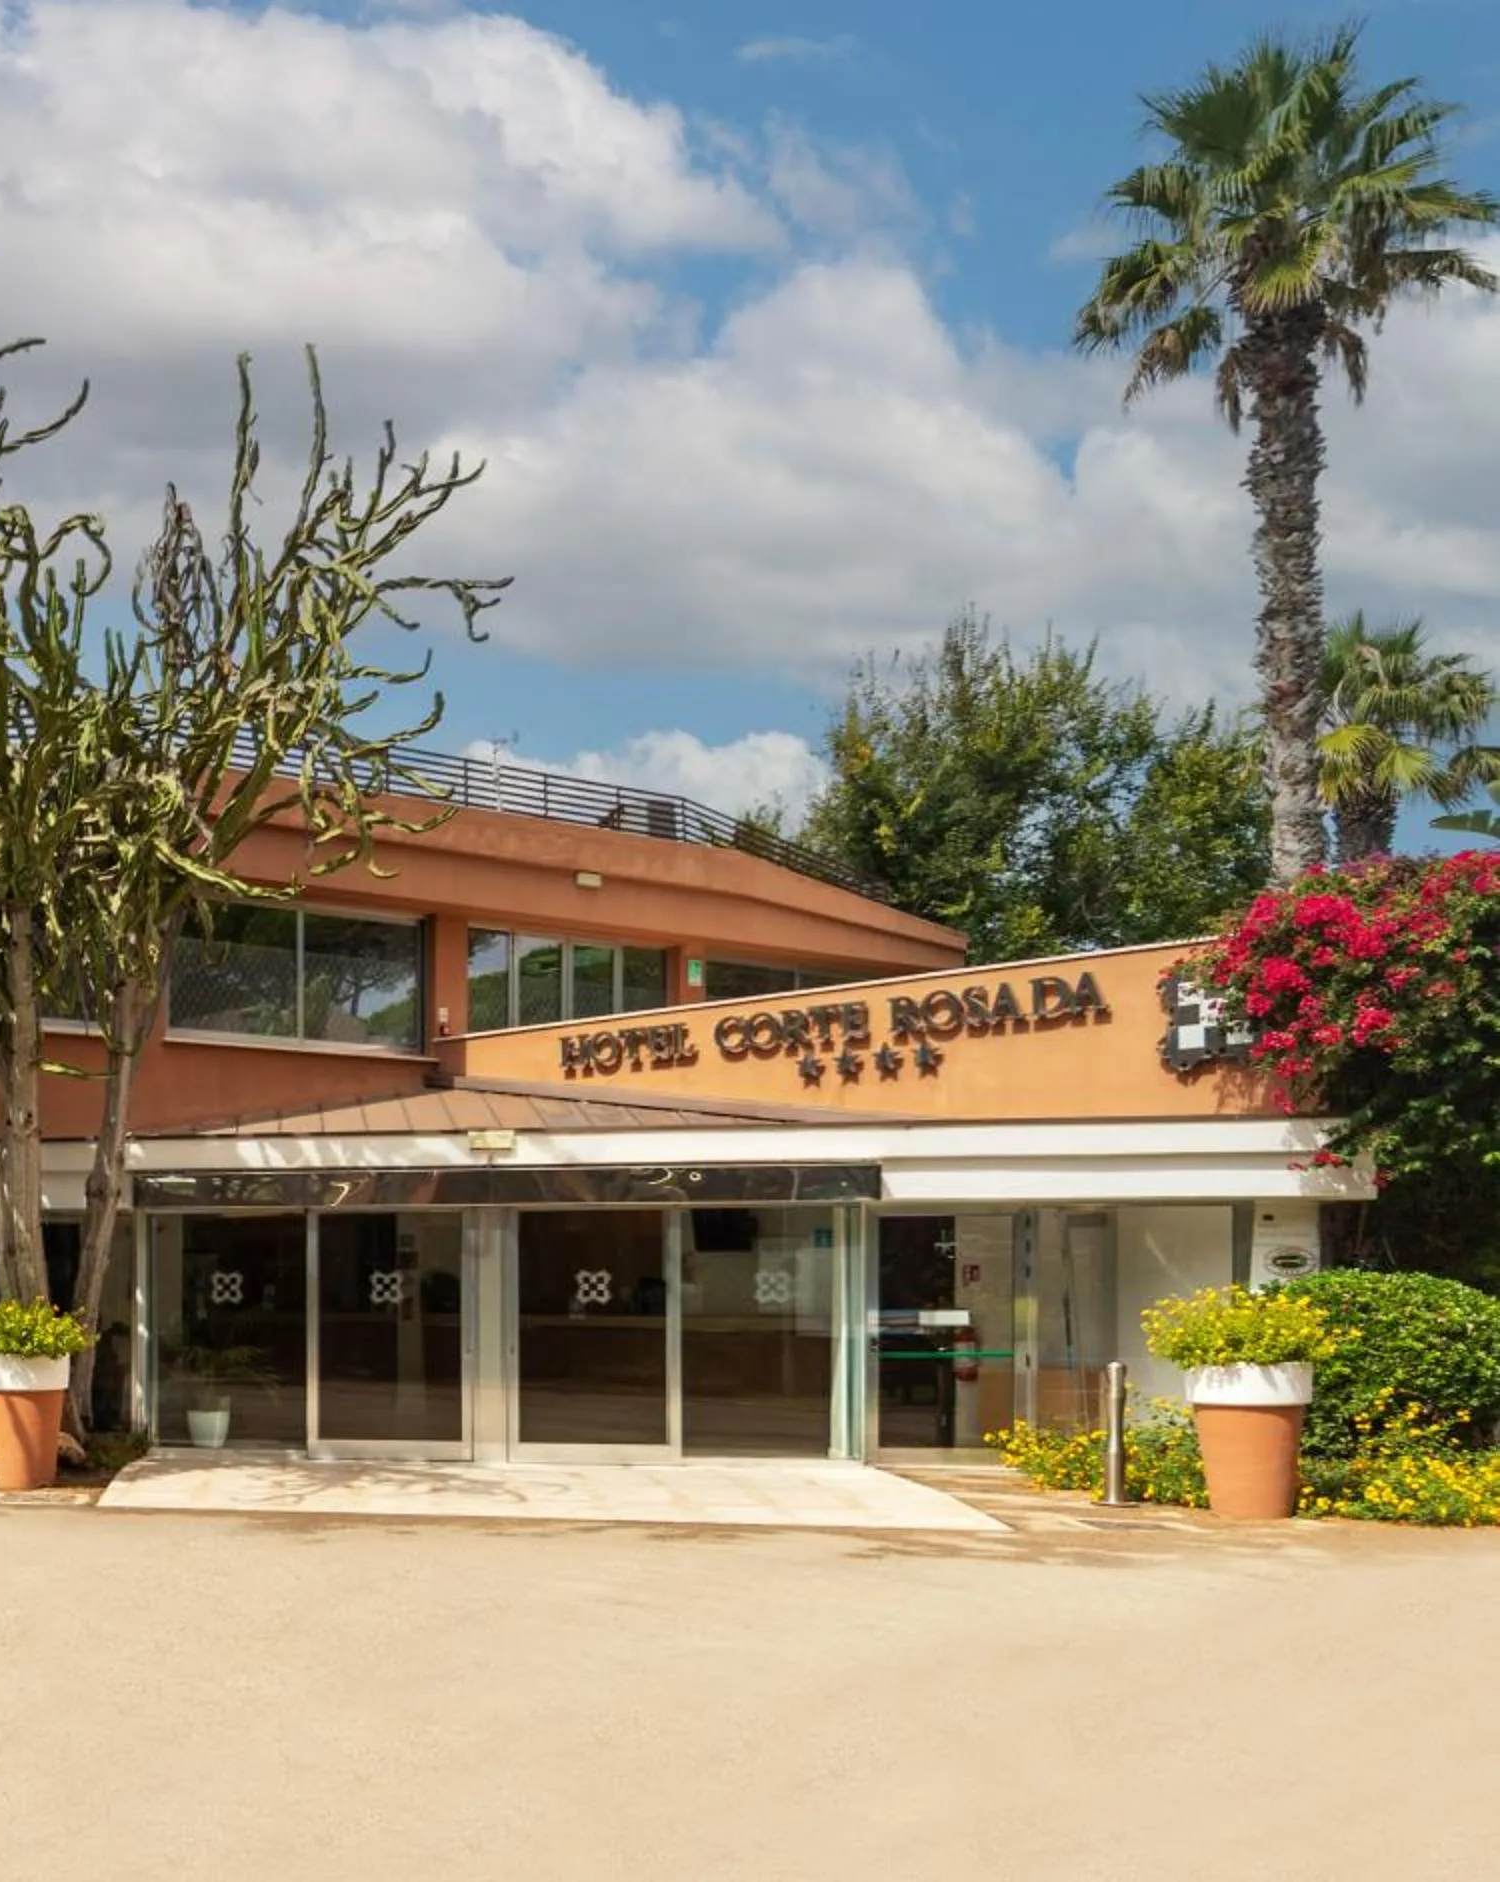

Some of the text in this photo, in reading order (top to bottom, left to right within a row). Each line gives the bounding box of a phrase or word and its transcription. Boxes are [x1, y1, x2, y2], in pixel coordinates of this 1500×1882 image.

[559, 971, 1110, 1073] HOTEL CORTE ROSADA
